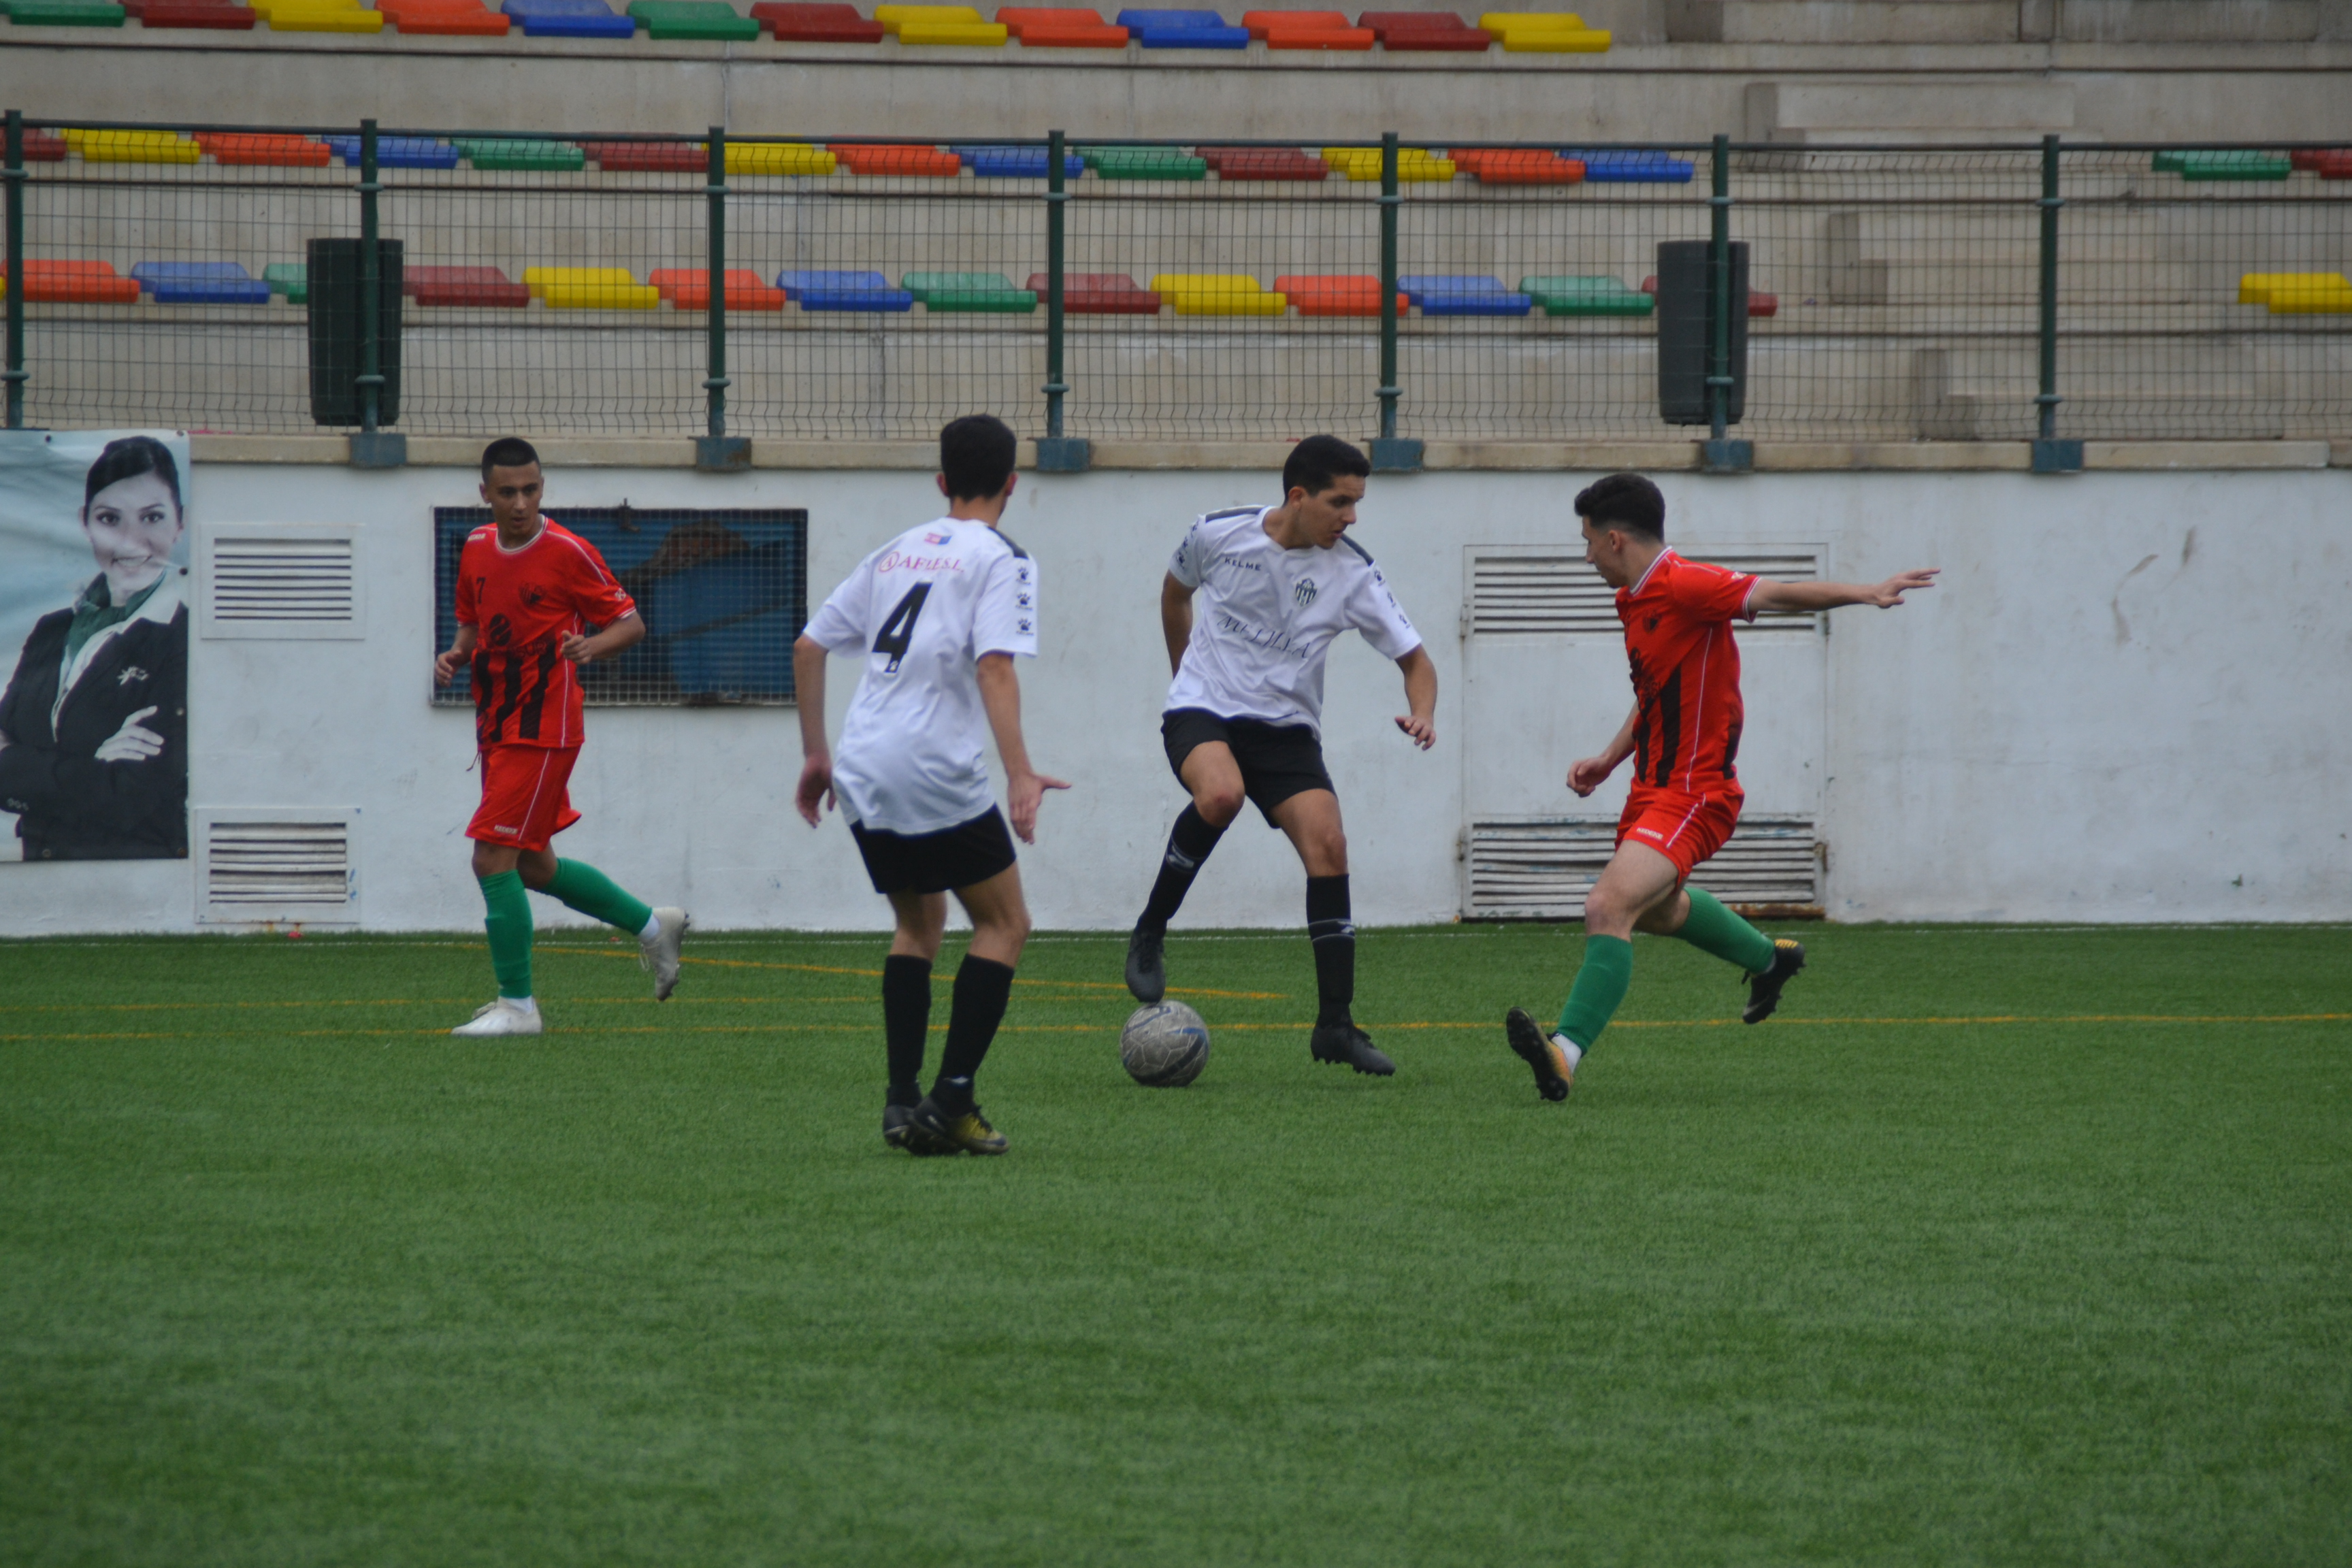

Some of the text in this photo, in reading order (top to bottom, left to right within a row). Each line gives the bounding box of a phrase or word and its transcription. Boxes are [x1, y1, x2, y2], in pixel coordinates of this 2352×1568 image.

[1224, 557, 1262, 571] KELME
[476, 576, 486, 604] 7
[871, 581, 933, 673] 4
